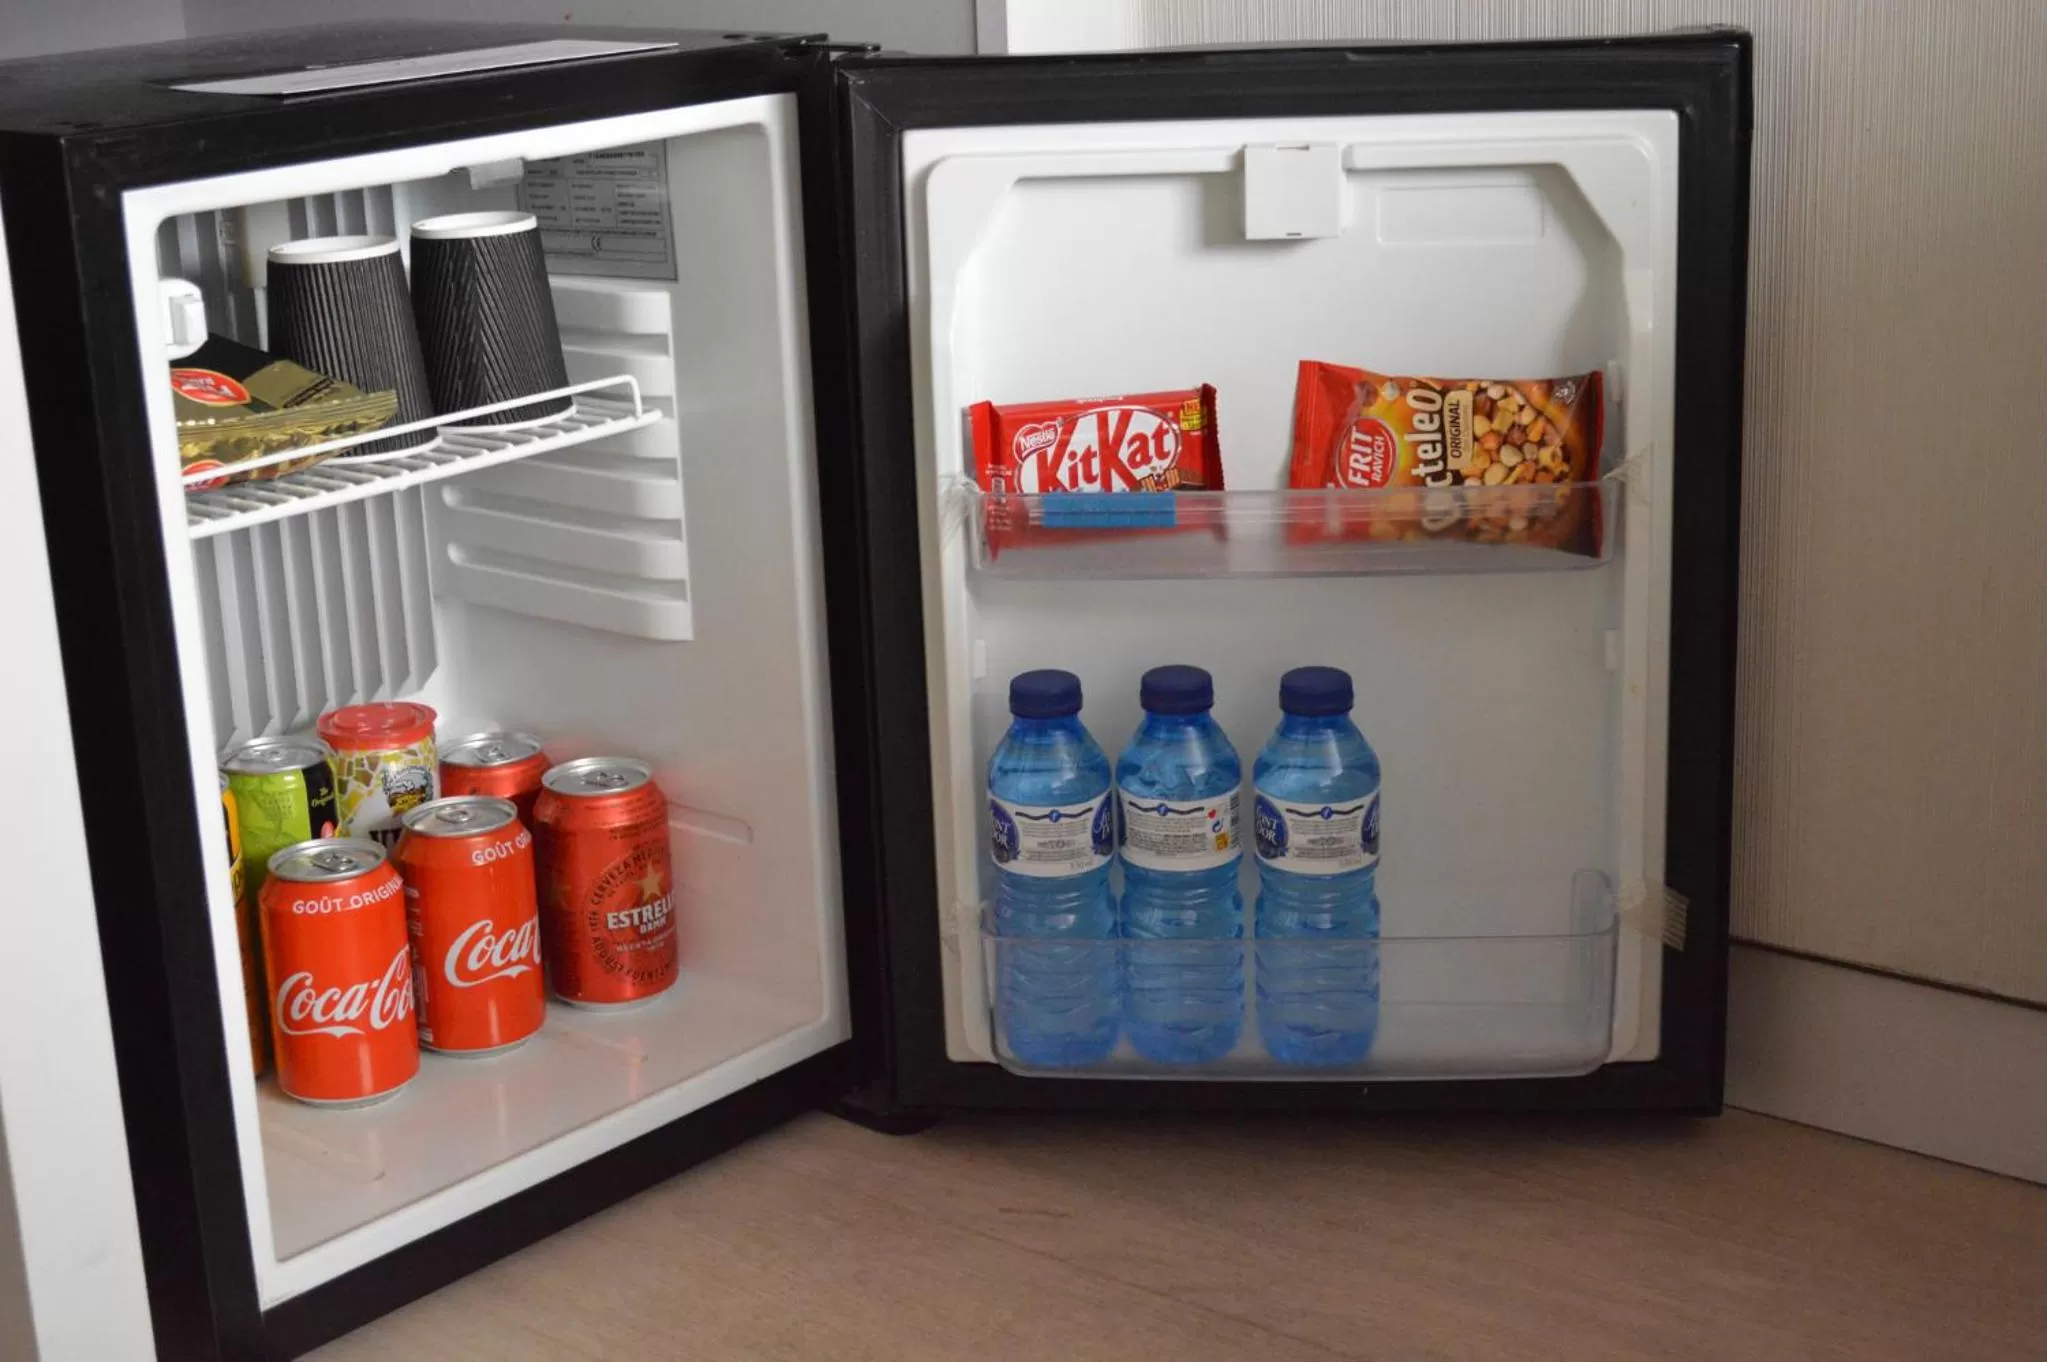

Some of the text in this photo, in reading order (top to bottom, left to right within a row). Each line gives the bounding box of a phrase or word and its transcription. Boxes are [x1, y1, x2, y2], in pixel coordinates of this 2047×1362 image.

[1036, 408, 1170, 493] KitKat
[1449, 398, 1462, 459] ORIGINAL
[1348, 426, 1373, 487] FRIT
[1371, 435, 1385, 482] RAVICH
[472, 841, 515, 866] GOÛT
[292, 875, 404, 914] GOÛT ORIGIN
